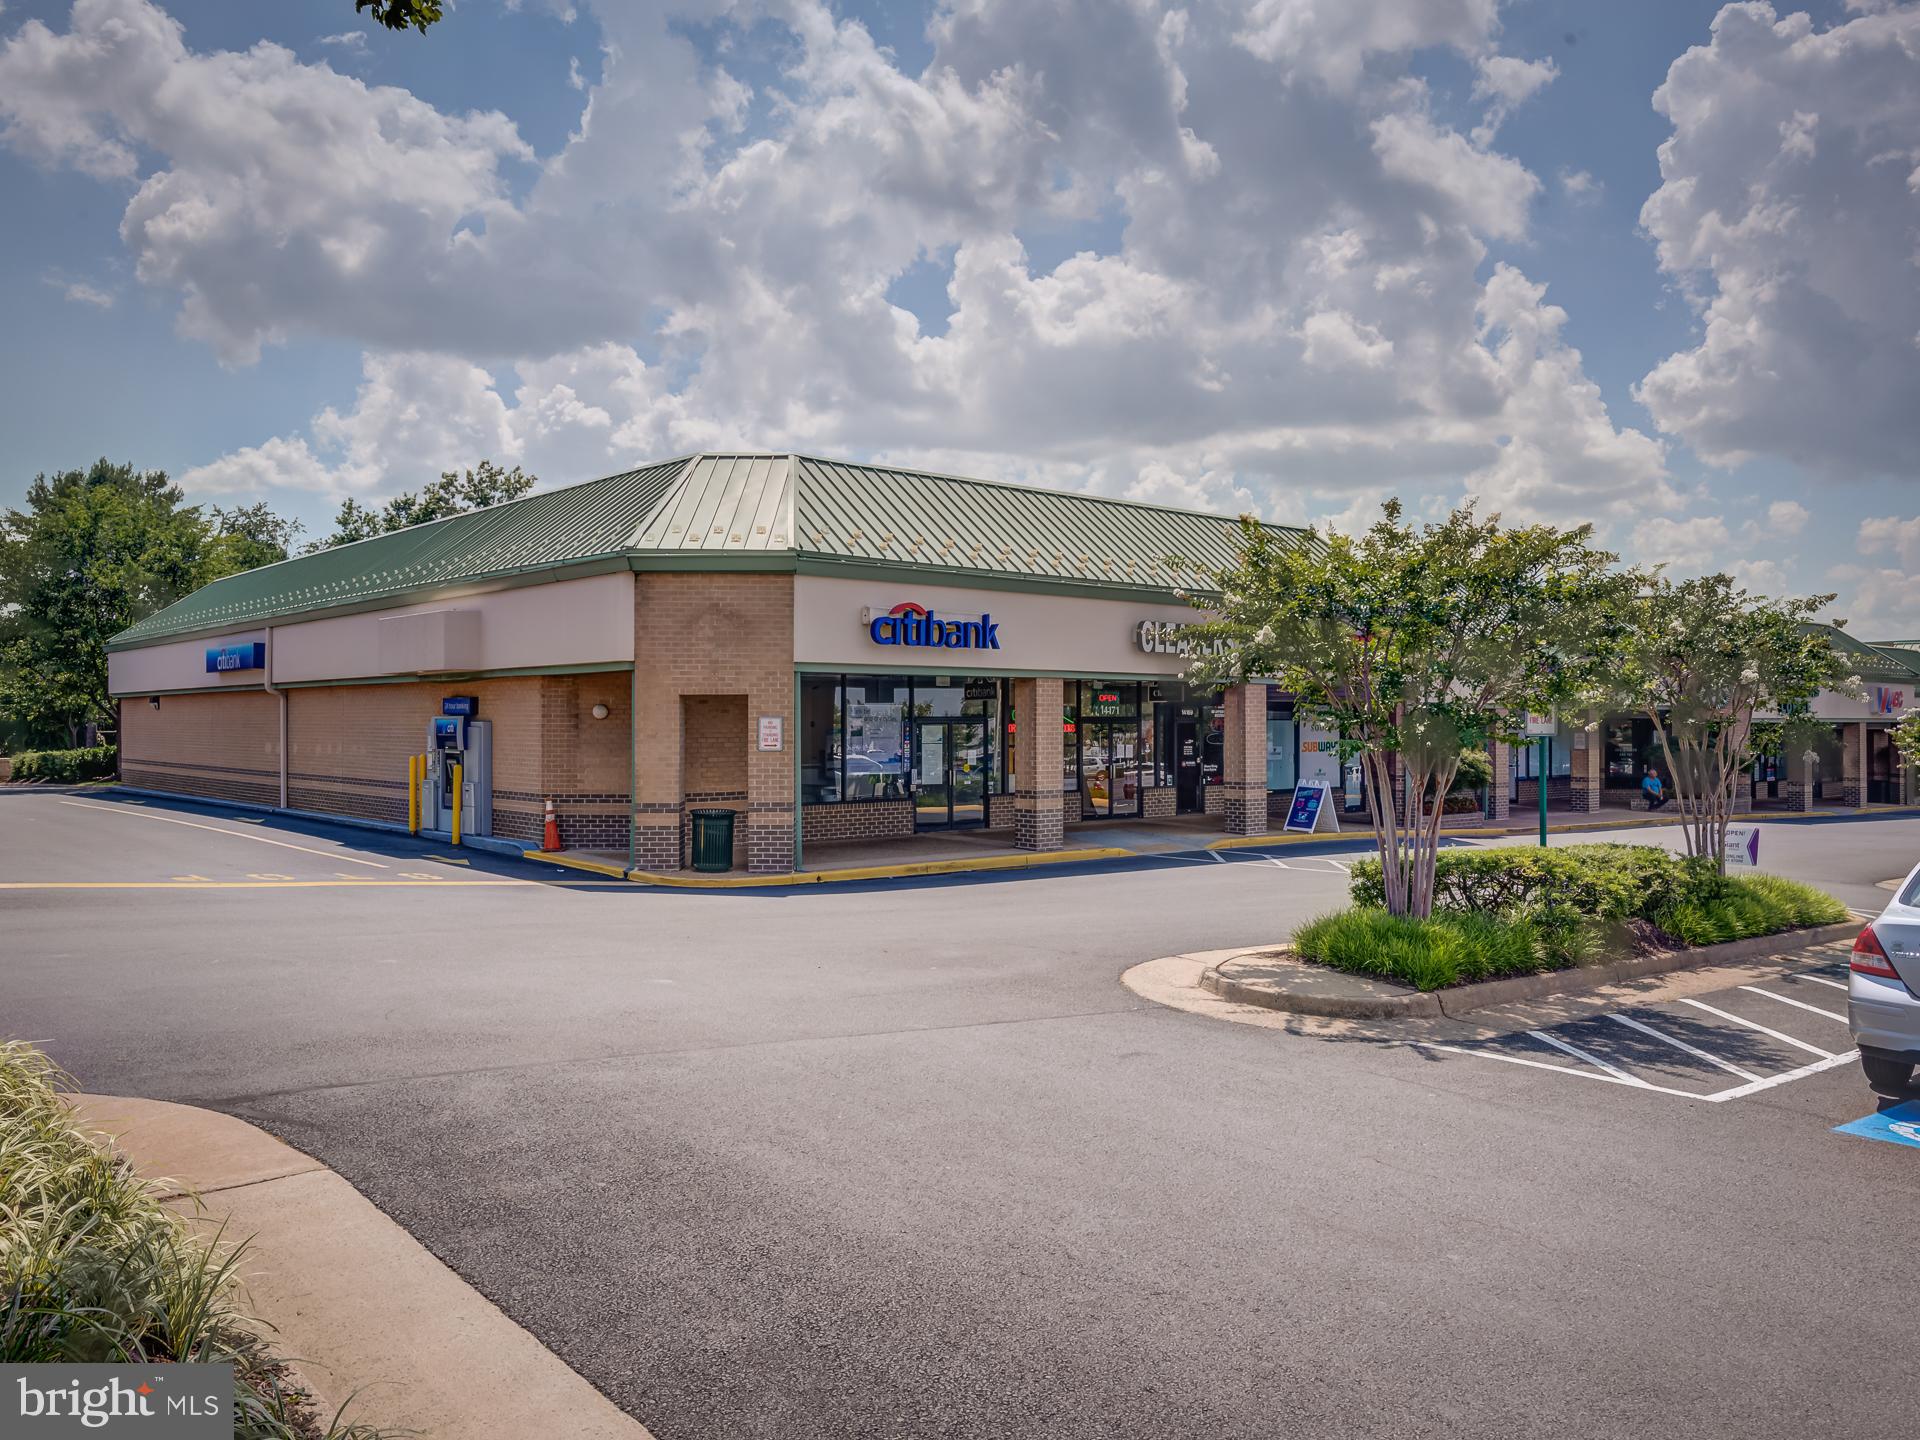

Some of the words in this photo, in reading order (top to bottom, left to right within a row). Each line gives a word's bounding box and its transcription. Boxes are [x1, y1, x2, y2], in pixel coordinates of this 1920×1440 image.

[870, 607, 1000, 649] citibank
[217, 652, 240, 670] citibank
[966, 686, 996, 698] citibank
[1099, 694, 1117, 702] OPEN
[1301, 741, 1339, 753] SUBWAY
